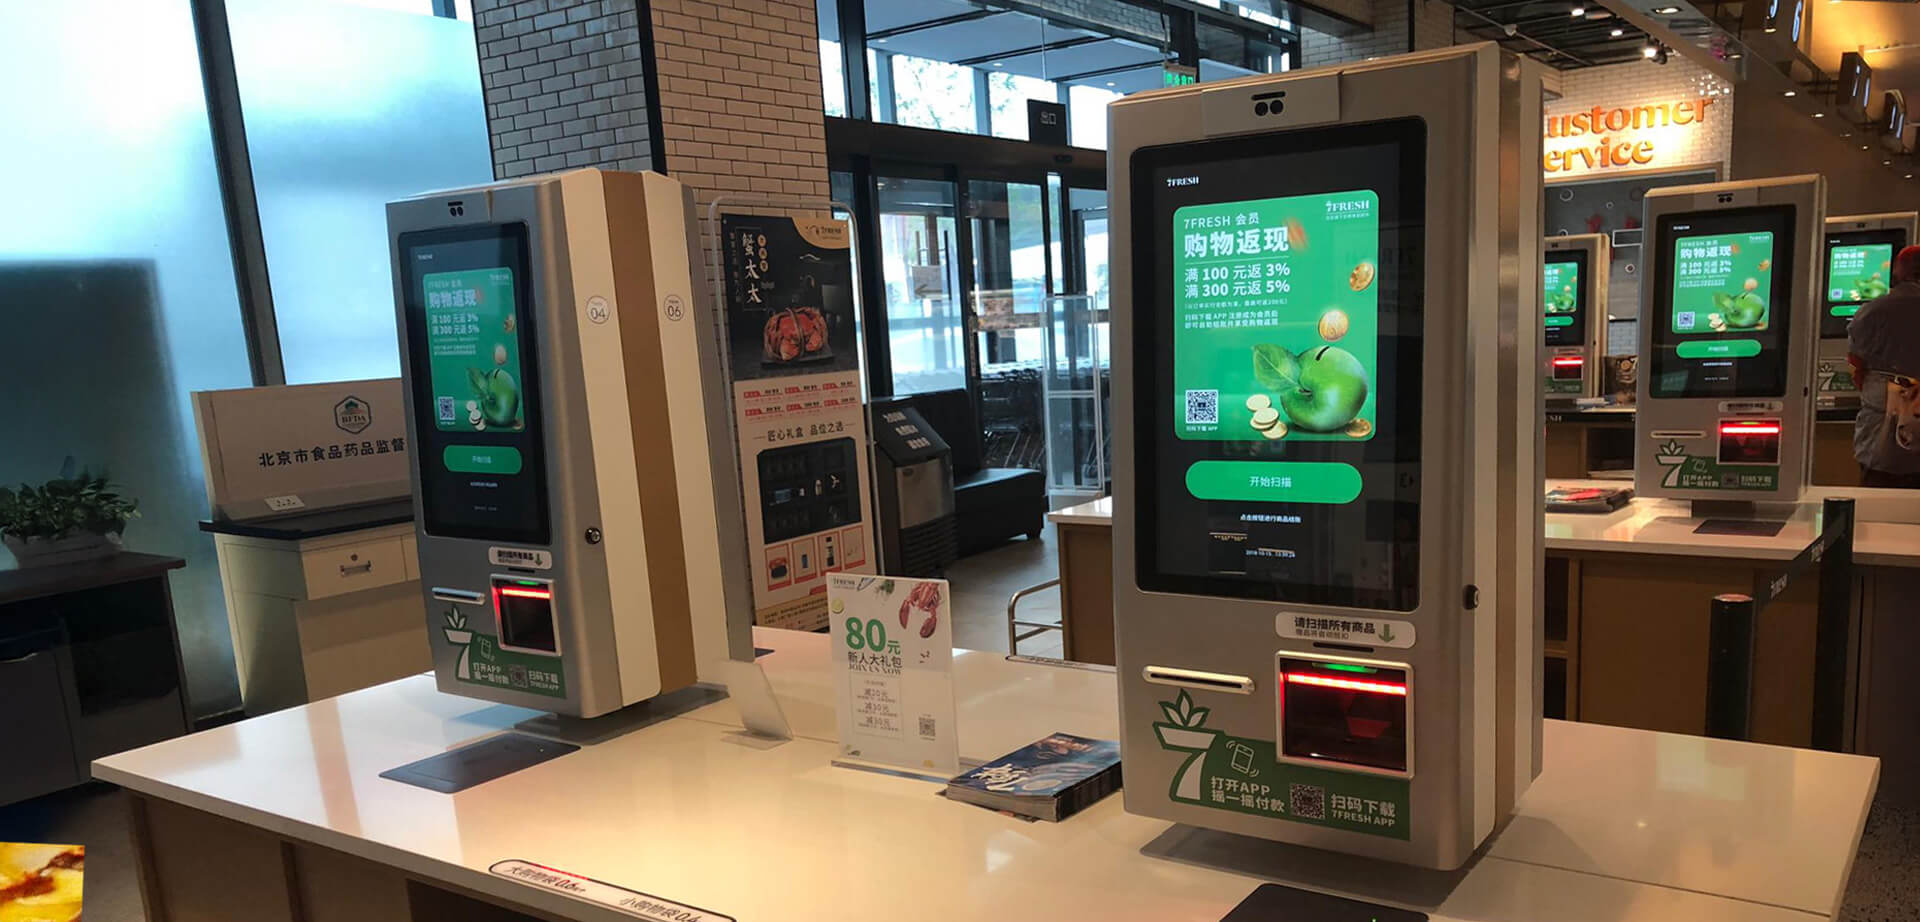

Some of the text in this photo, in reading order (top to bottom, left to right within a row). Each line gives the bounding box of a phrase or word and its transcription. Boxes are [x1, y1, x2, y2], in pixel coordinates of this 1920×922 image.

[1544, 97, 1714, 138] ustomer
[1544, 137, 1654, 172] ervice
[1167, 176, 1199, 187] 7FRESH
[1325, 200, 1370, 213] 7FRESH
[1184, 212, 1260, 229] 7FRESH 会员
[1184, 226, 1289, 258] 购物返现
[1185, 262, 1291, 282] 满 100 元返 3%
[1185, 280, 1291, 299] 满 300 元返 5%
[590, 307, 605, 320] 04
[667, 305, 681, 318] 06
[259, 437, 405, 468] 北京市食品药品监督
[1249, 476, 1293, 489] 开始扫描
[1294, 616, 1376, 635] 请扫描所有商品
[848, 651, 903, 669] 新人大礼包
[1211, 776, 1271, 796] 打开APP
[1211, 789, 1285, 814] 摇一摇付款
[1331, 795, 1396, 818] 扫码下载
[1332, 810, 1396, 828] 7FRESH APP
